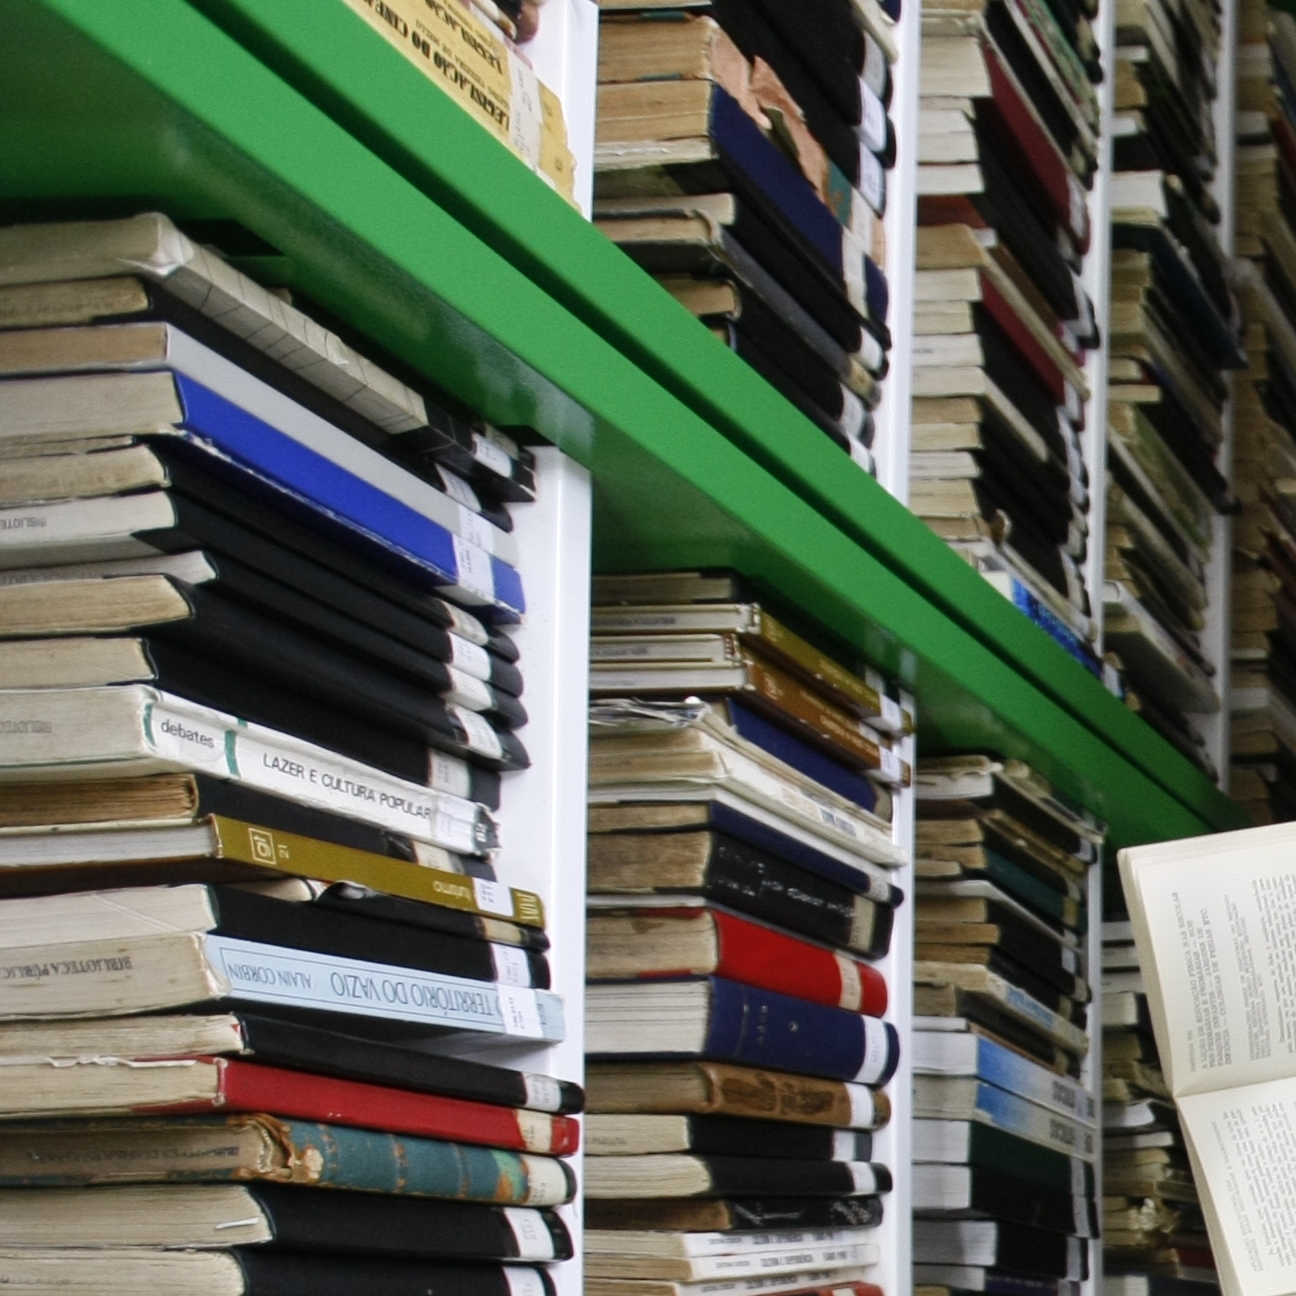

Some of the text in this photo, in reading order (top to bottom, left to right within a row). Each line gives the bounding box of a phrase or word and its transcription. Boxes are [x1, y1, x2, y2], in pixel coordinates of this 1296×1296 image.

[160, 717, 215, 750] debates
[263, 752, 432, 821] LAZER E CULTURA POPULAR
[226, 962, 313, 989] ALAIN CORBIN
[330, 971, 381, 1002] VAZIO
[382, 979, 410, 1003] DO
[410, 983, 494, 1017] TERRITÓRIO
